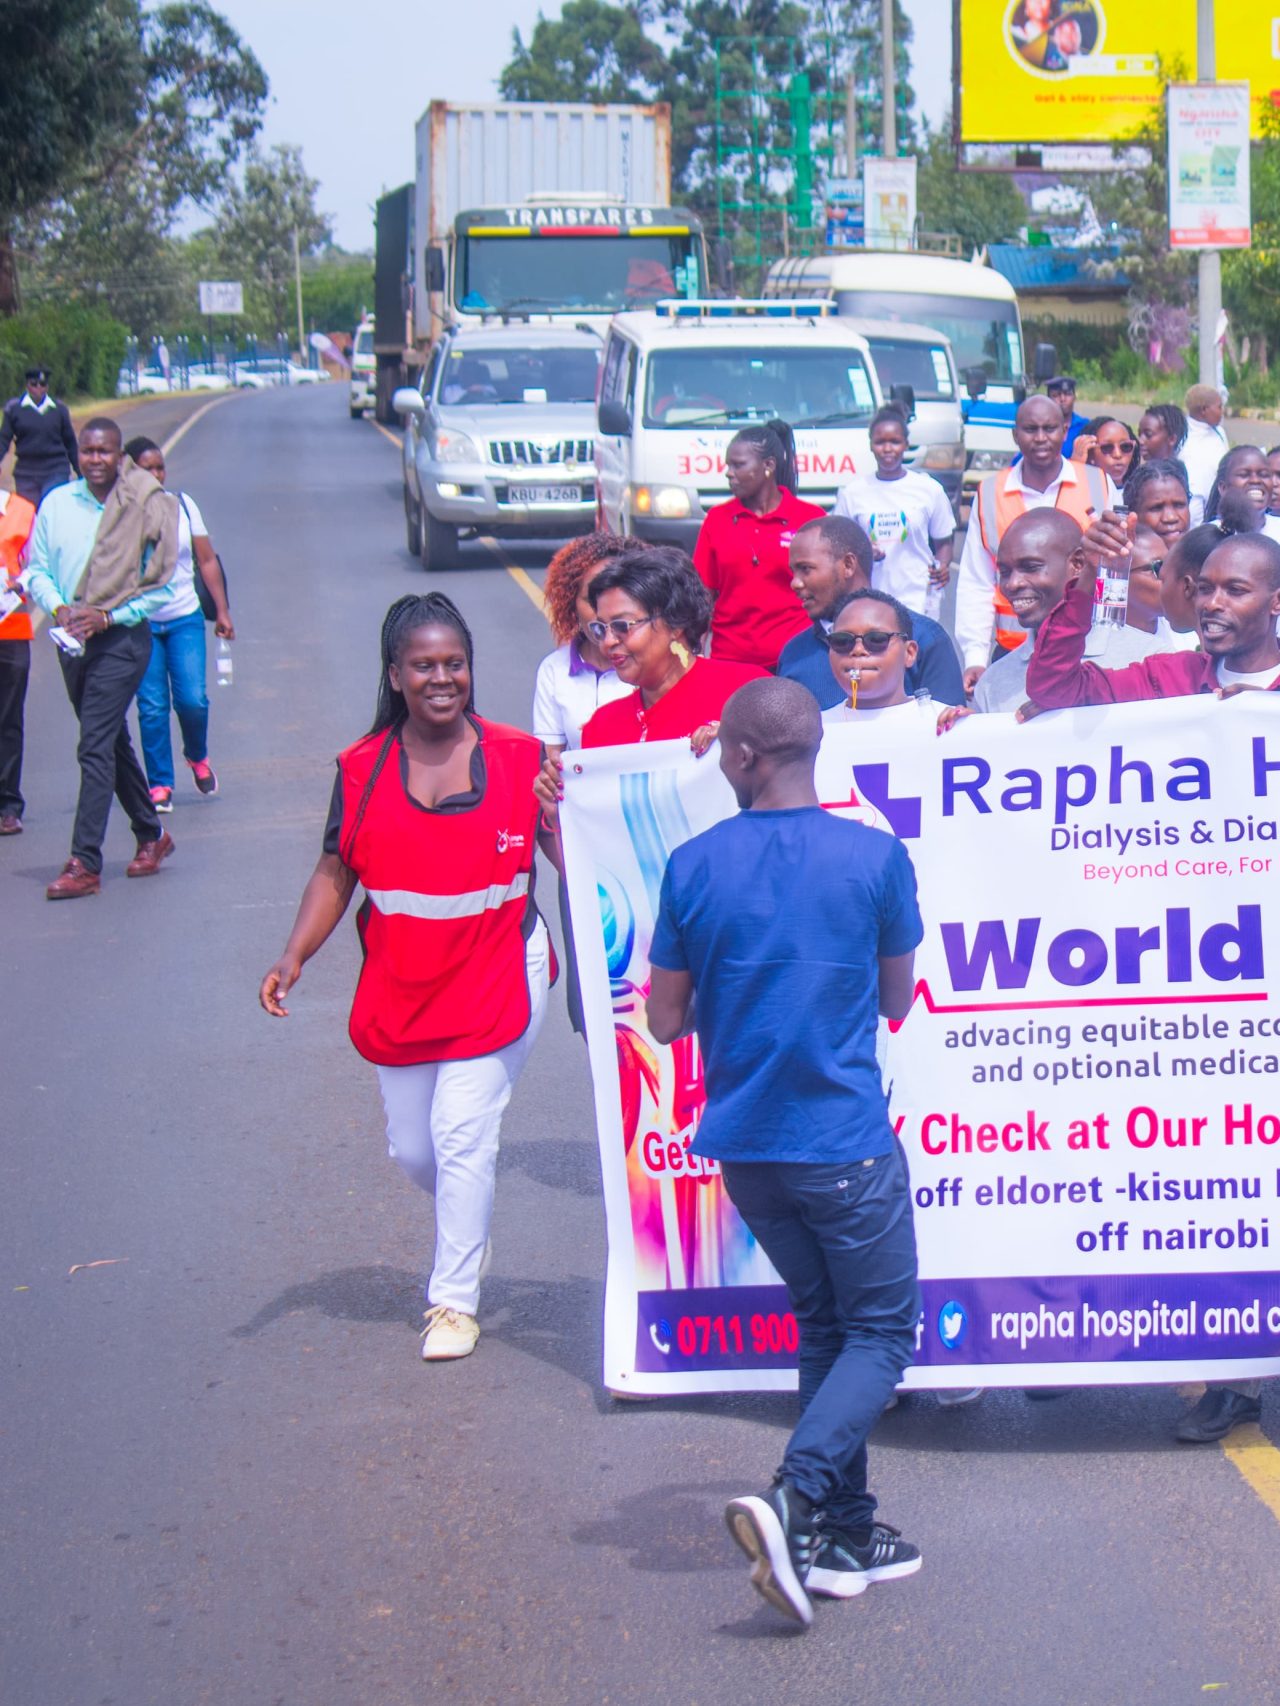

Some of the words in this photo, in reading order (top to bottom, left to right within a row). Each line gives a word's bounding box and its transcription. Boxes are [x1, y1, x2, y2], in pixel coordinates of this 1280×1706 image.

[505, 207, 654, 226] TRANSPARES
[511, 488, 537, 501] KBU
[942, 745, 1211, 825] Rapha
[1051, 819, 1180, 855] Dialysis
[1190, 820, 1215, 845] &
[1083, 858, 1169, 884] Beyond
[1175, 858, 1233, 877] Care,
[1239, 855, 1273, 873] For
[940, 903, 1265, 992] World
[944, 1021, 1072, 1050] advacing
[1081, 1011, 1230, 1048] equitable
[971, 1056, 1024, 1084] and
[1033, 1051, 1162, 1086] optional
[920, 1110, 1052, 1156] Check
[1066, 1111, 1111, 1151] at
[1126, 1105, 1208, 1150] Our
[915, 1177, 963, 1209] off
[974, 1174, 1104, 1206] eldoret
[1114, 1170, 1262, 1202] -kisumu
[1075, 1221, 1130, 1253] off
[1142, 1217, 1270, 1250] nairobi
[677, 1314, 745, 1357] 0711
[991, 1302, 1076, 1350] rapha
[1081, 1298, 1197, 1349] hospital
[1203, 1301, 1260, 1336] and
